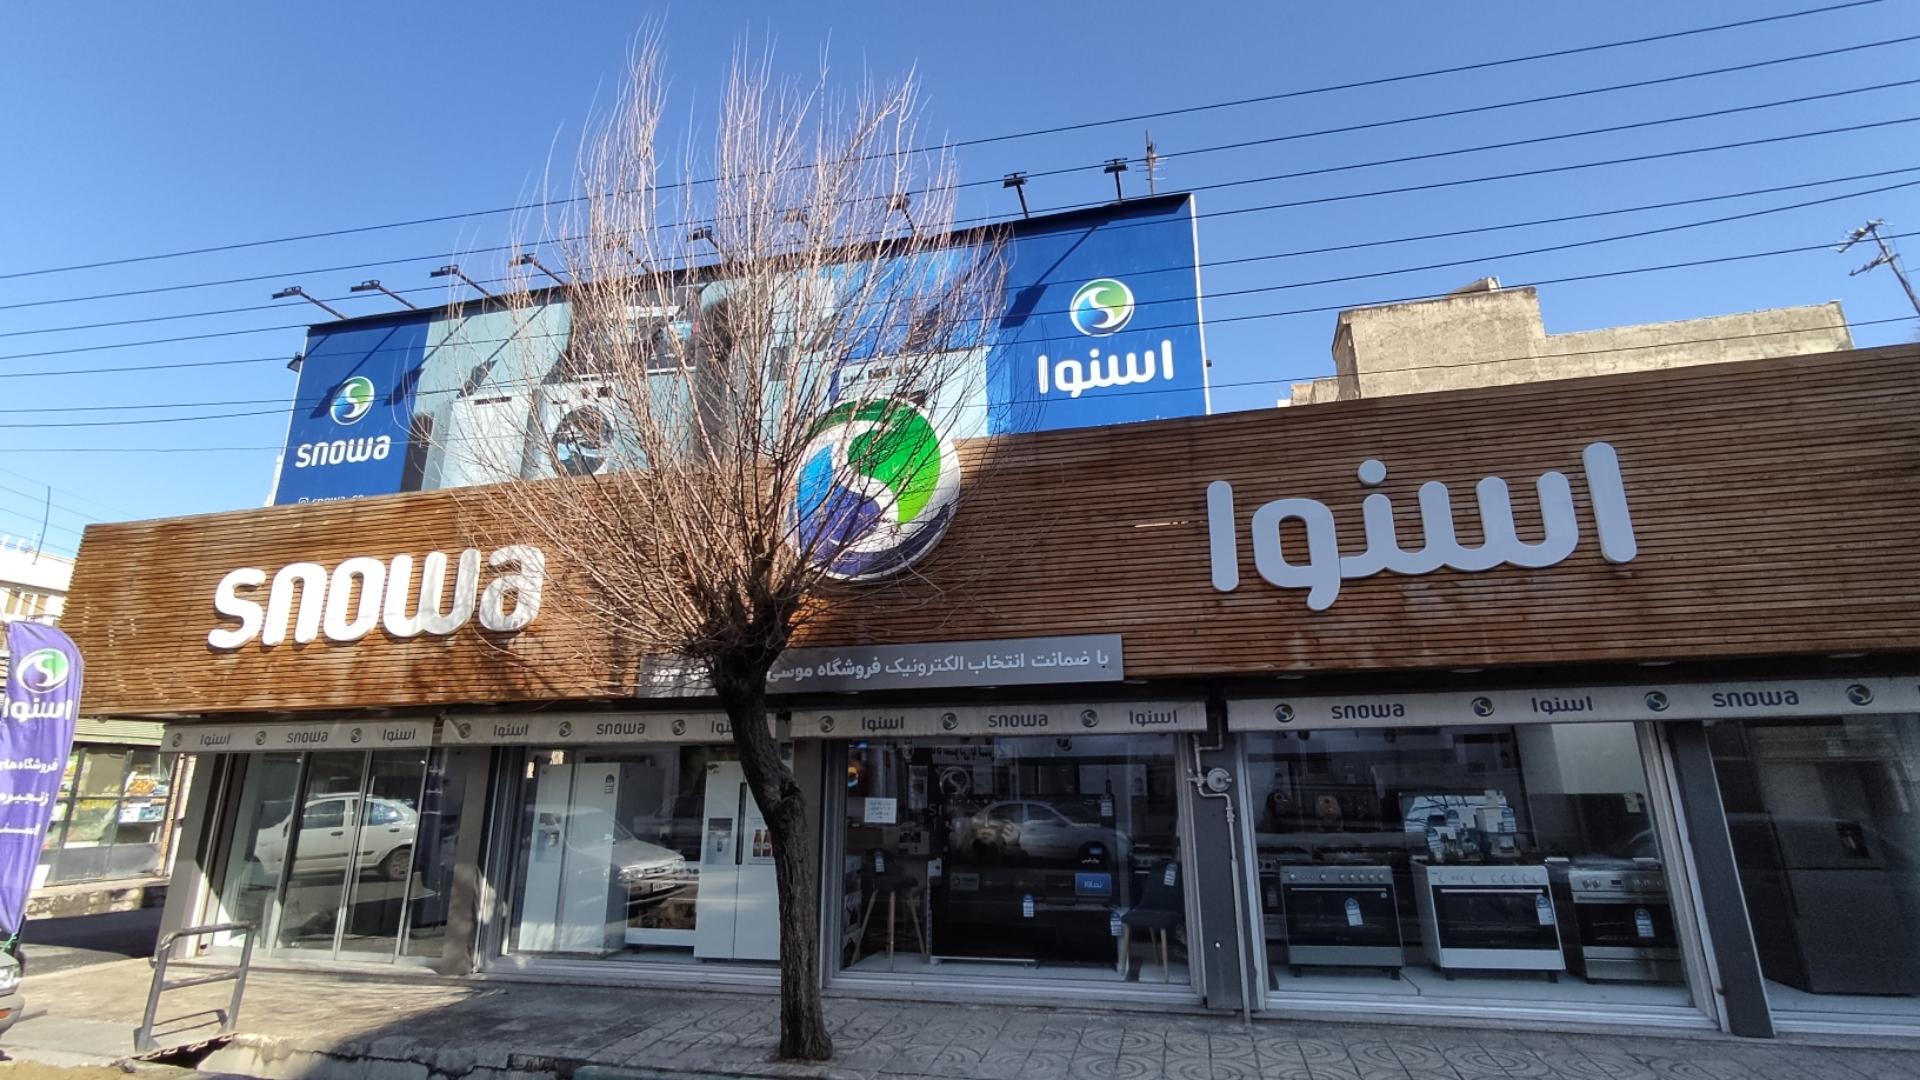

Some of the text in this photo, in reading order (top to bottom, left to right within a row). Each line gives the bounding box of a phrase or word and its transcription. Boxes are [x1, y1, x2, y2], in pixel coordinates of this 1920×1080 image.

[1037, 339, 1174, 398] اسنوا
[295, 435, 391, 468] snowa
[1206, 441, 1637, 612] اسنوا
[207, 545, 546, 651] snowa
[817, 656, 881, 680] فروشگاه
[885, 655, 964, 679] الکترونیک
[967, 653, 1025, 675] انتخاب
[1031, 649, 1090, 668] ضمانت
[1096, 649, 1109, 668] با
[1532, 696, 1593, 717] اسنوا
[1712, 689, 1799, 708] snowa
[2, 697, 73, 722] اسنوا
[1129, 708, 1177, 727] اسنوا
[1331, 702, 1405, 720] snowa
[596, 720, 646, 735] snowa
[861, 716, 904, 733] اسنوا
[988, 712, 1049, 728] snowa
[199, 732, 231, 746] اسنوا
[286, 730, 329, 744] snowa
[382, 727, 416, 742] اسنوا
[492, 722, 530, 738] اسنوا
